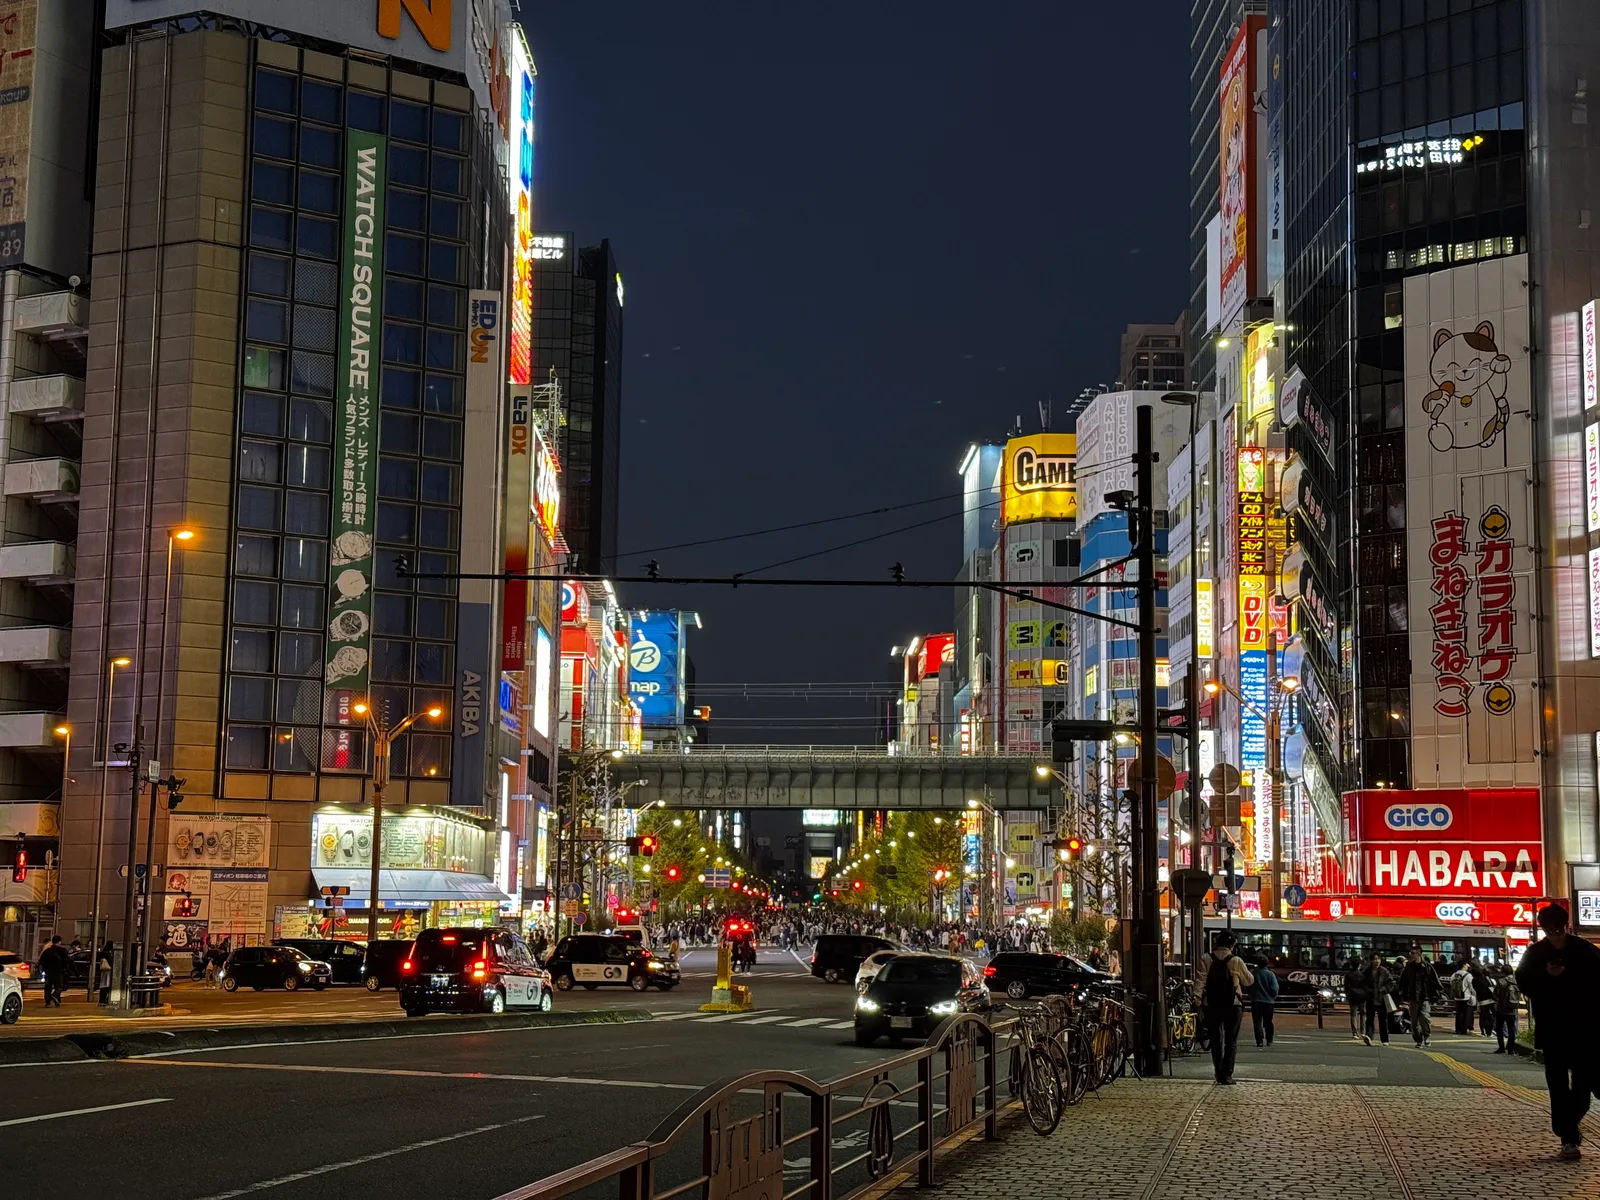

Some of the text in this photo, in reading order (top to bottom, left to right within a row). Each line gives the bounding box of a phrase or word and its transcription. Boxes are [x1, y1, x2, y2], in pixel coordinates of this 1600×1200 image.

[349, 146, 377, 390] WATCH SQUARE
[470, 299, 497, 364] EDION
[341, 393, 357, 524] 人気ブランド多数取り揃え
[354, 395, 370, 526] メンズ・レディース腕時計
[1241, 492, 1262, 503] ゲーム
[1243, 505, 1261, 514] CD
[1240, 516, 1264, 527] アイドル
[1240, 528, 1264, 538] アニメ
[1240, 540, 1263, 551] コミック
[1243, 595, 1263, 645] DVD
[1430, 510, 1473, 718] まねきねこ
[1476, 538, 1515, 683] カラオケ
[510, 626, 518, 658] Electronics
[461, 669, 482, 738] AKIBA
[1387, 806, 1451, 828] GiGO
[604, 967, 622, 979] GO
